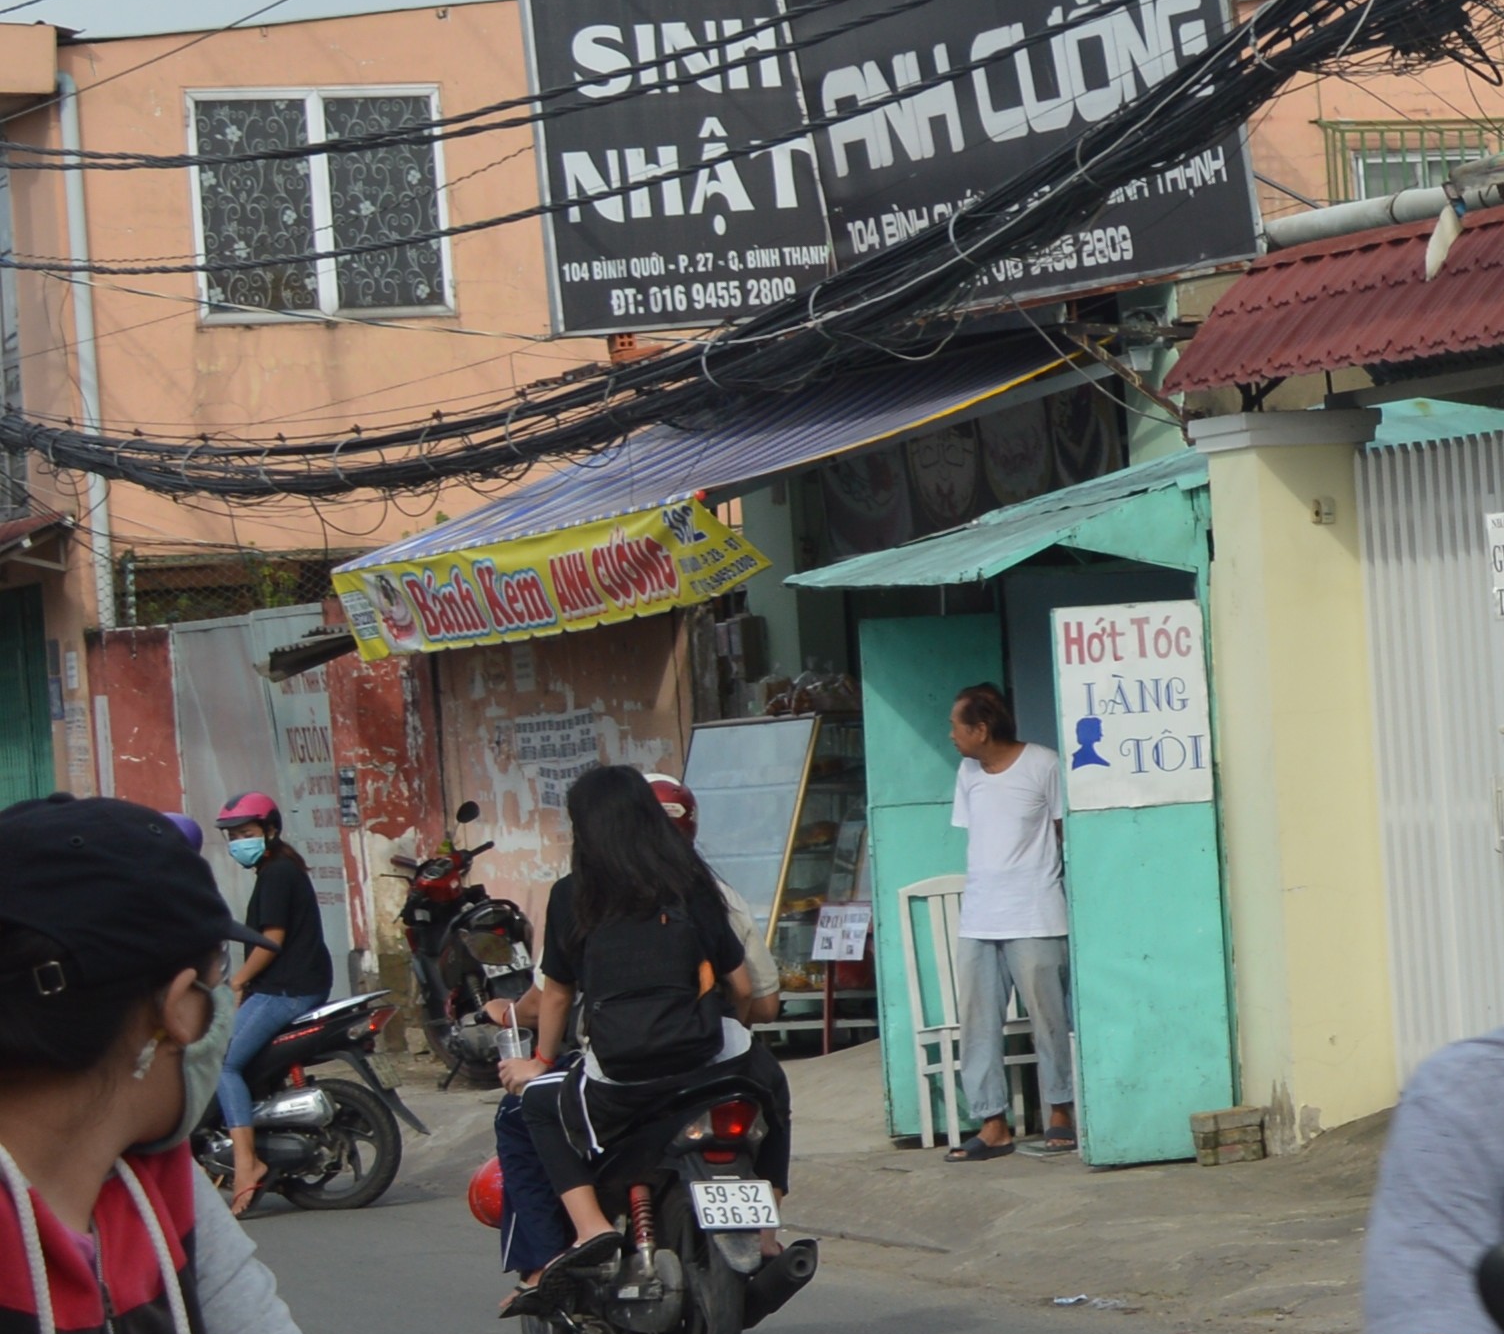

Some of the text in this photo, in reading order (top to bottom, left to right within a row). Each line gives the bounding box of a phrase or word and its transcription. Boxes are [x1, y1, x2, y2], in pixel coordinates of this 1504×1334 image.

[571, 17, 783, 99] SINH
[822, 42, 965, 177] ANH
[561, 117, 814, 236] NHẬT
[847, 221, 880, 255] 104
[1082, 225, 1134, 267] 2809
[563, 261, 590, 282] 104
[592, 255, 628, 281] BÌNH
[696, 252, 714, 273] 27
[746, 244, 780, 269] BÌNH
[782, 245, 830, 270] THẠNH
[610, 275, 797, 317] ĐT: 016 9455 2809
[402, 566, 491, 642] Bánh
[472, 558, 557, 633] Kem
[550, 549, 609, 622] ANH
[1063, 614, 1192, 665] Hớt Tóc
[1082, 674, 1190, 717] LÀNG
[1119, 729, 1207, 774] TÔI
[702, 1205, 775, 1225] 636.32
[704, 1185, 763, 1204] 59-S2
